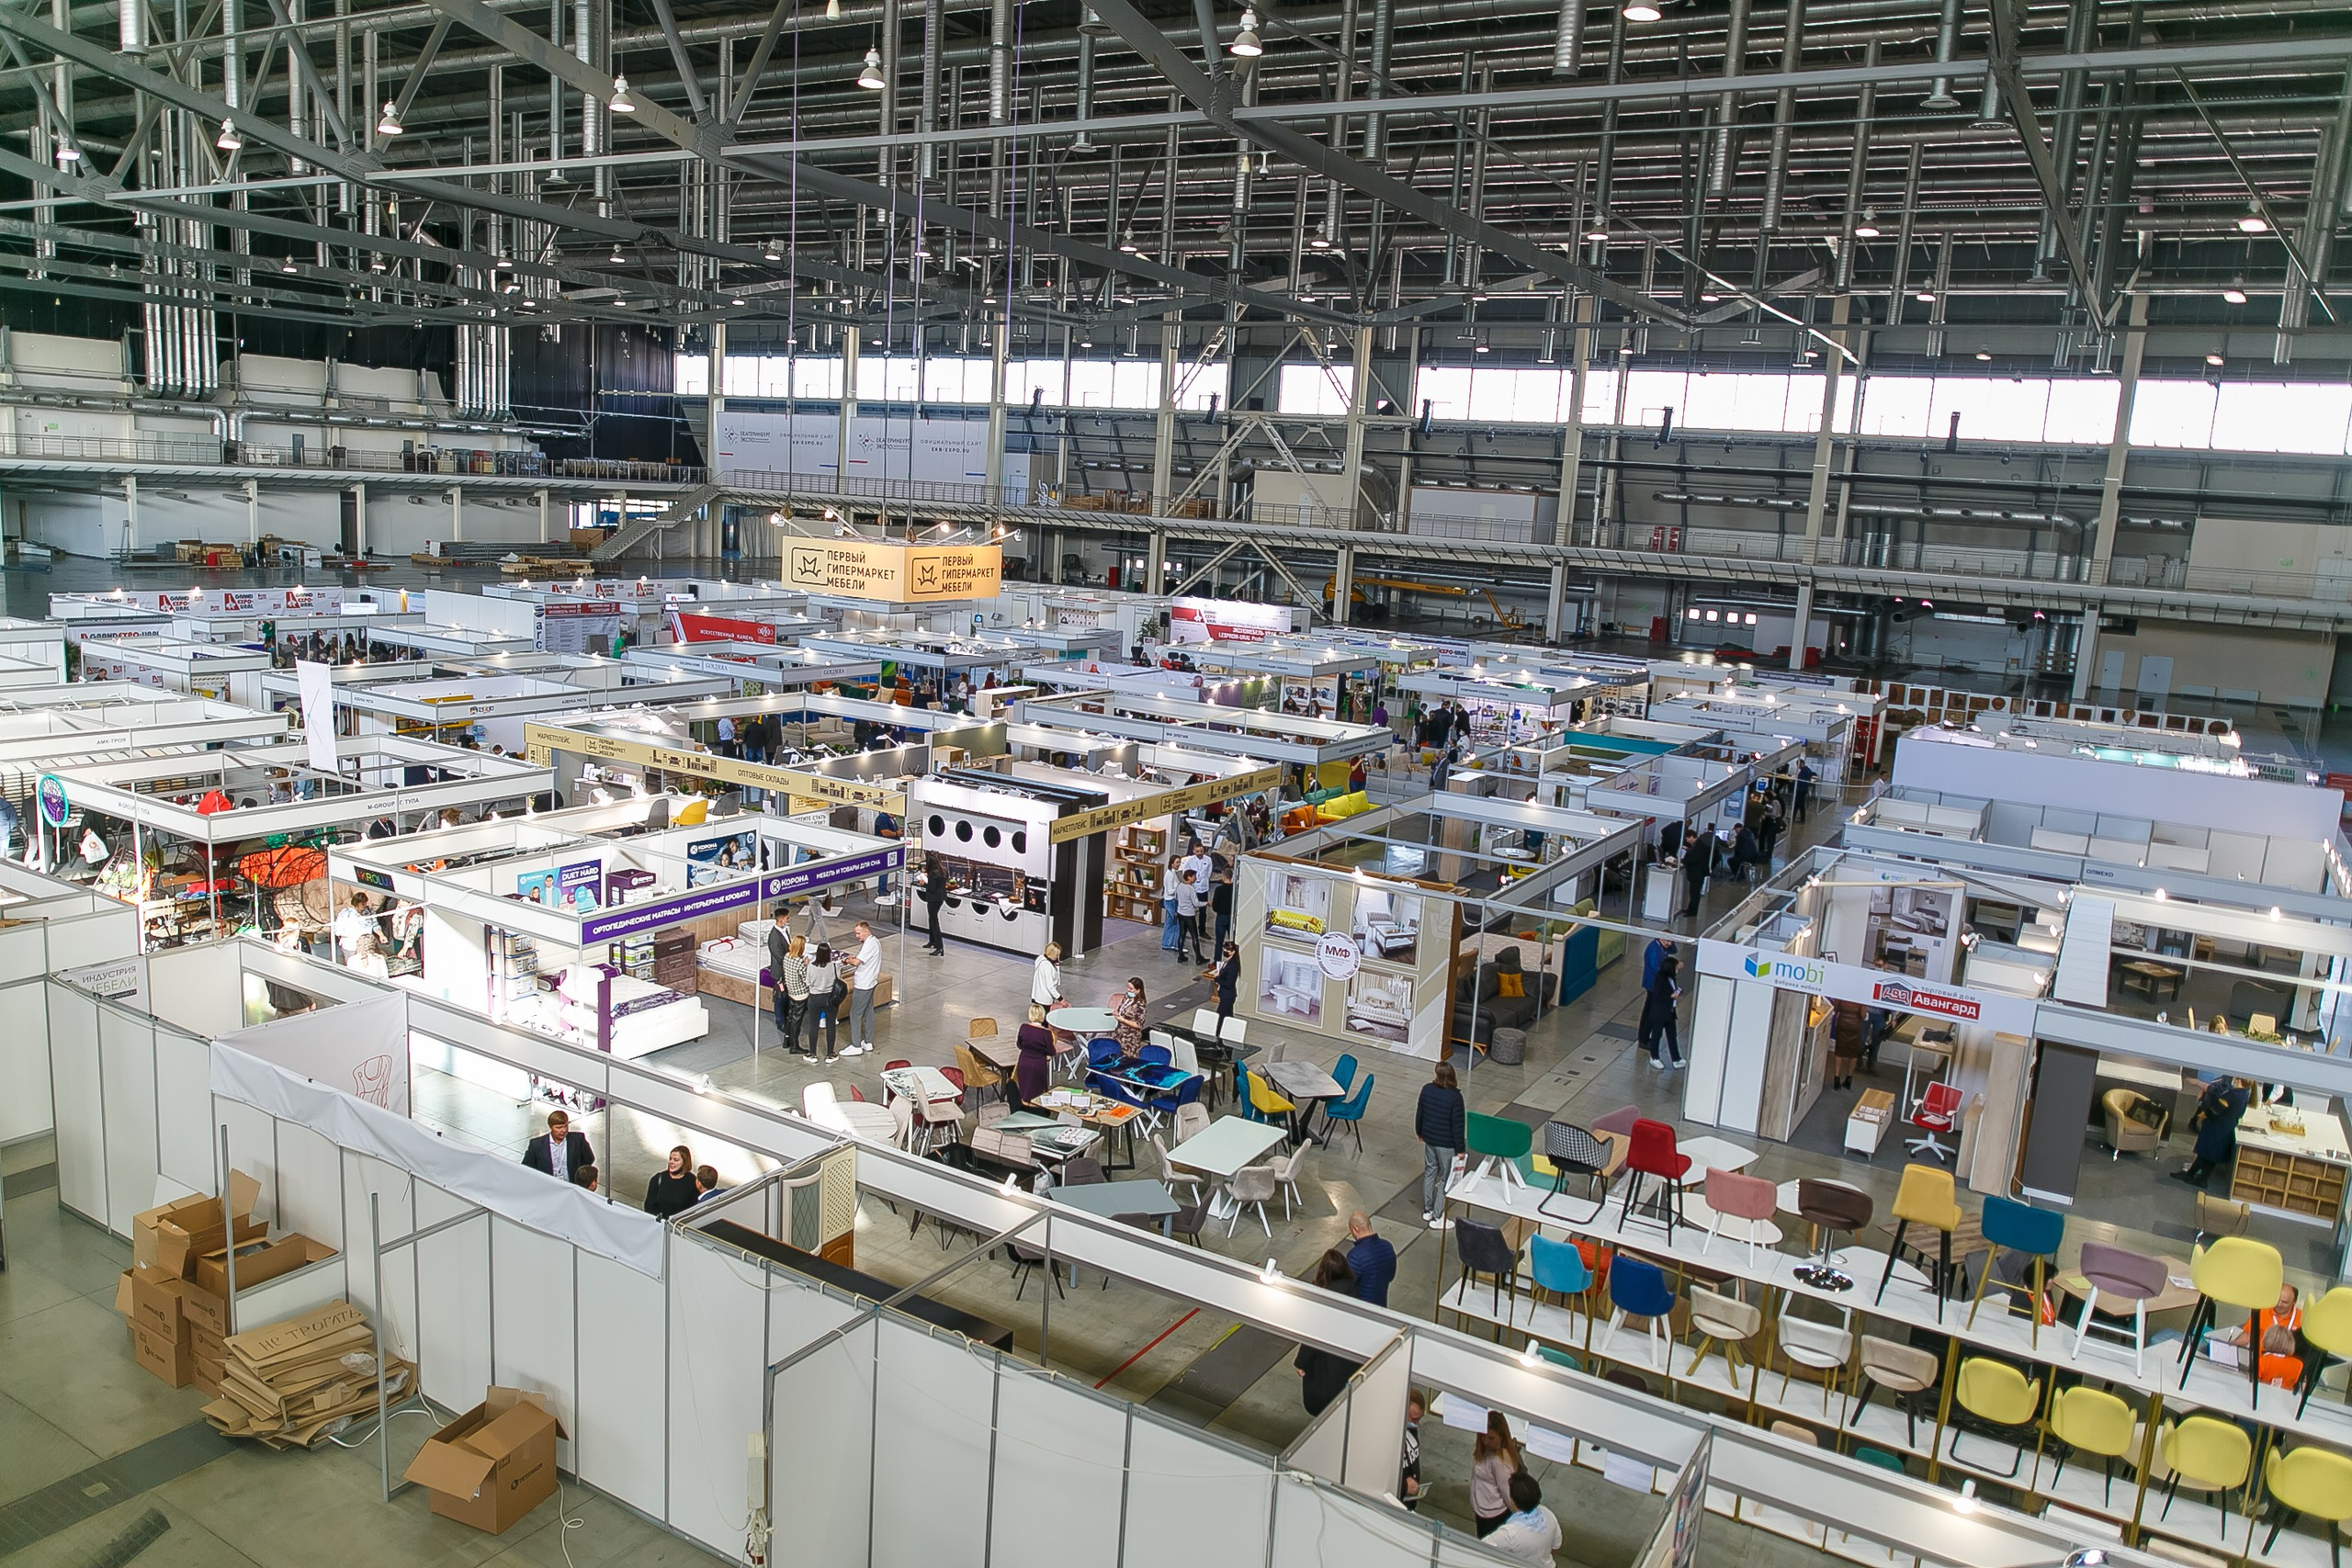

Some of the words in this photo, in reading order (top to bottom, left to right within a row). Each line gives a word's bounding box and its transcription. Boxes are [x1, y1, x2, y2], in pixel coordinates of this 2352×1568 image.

[827, 549, 865, 564] ПЕРВЫЙ
[942, 553, 974, 567] ПЕРВЫЙ
[826, 563, 896, 581] ГИПЕРМАРКЕТ
[941, 567, 995, 581] ГИПЕРМАРКЕТ
[826, 576, 865, 591] МЕБЕЛИ
[941, 581, 973, 592] МЕБЕЛИ
[699, 628, 735, 639] ИСКУССТВЕННЫЙ
[705, 662, 729, 671] GOLDERA
[822, 668, 845, 676] GOLDERA
[537, 732, 571, 745] МАРКЕТПЛЕЙС
[598, 738, 615, 747] ПЕРВЫЙ
[598, 743, 626, 753] ГИПЕРМАРКЕТ
[738, 769, 764, 781] ОПТОВЫЕ
[765, 773, 790, 785] СКЛАДЫ
[368, 801, 395, 810] M-GROUP
[1052, 818, 1087, 837] МАРКЕТПЛЕЙС
[561, 872, 580, 881] DUET
[580, 867, 599, 876] HARD
[816, 870, 835, 879] МЕБЕЛЬ
[841, 864, 860, 874] ТОВАРЫ
[860, 862, 870, 870] ДЛЯ
[870, 859, 881, 867] СНА
[2086, 869, 2114, 878] ОЛМЕКО
[356, 871, 392, 886] KROLU
[781, 874, 809, 886] КОРОНА
[593, 913, 651, 935] ОРТОПЕДИЧЕСКИЕ
[651, 907, 681, 919] МАТРАСЫ
[684, 896, 725, 912] ИНТЕРЬЕРНЫЕ
[725, 889, 751, 902] КРОВАТИ
[1325, 944, 1351, 959] ММФ
[82, 965, 137, 984] ИНДУСТРИЯ
[1774, 961, 1825, 985] mobi
[1774, 978, 1799, 988] фабрика
[1801, 984, 1823, 992] мебели
[1921, 986, 1958, 999] торговый
[1959, 993, 1975, 1002] дом
[1913, 995, 1978, 1018] Авангард
[285, 1309, 362, 1340] ТРОГАТЬ
